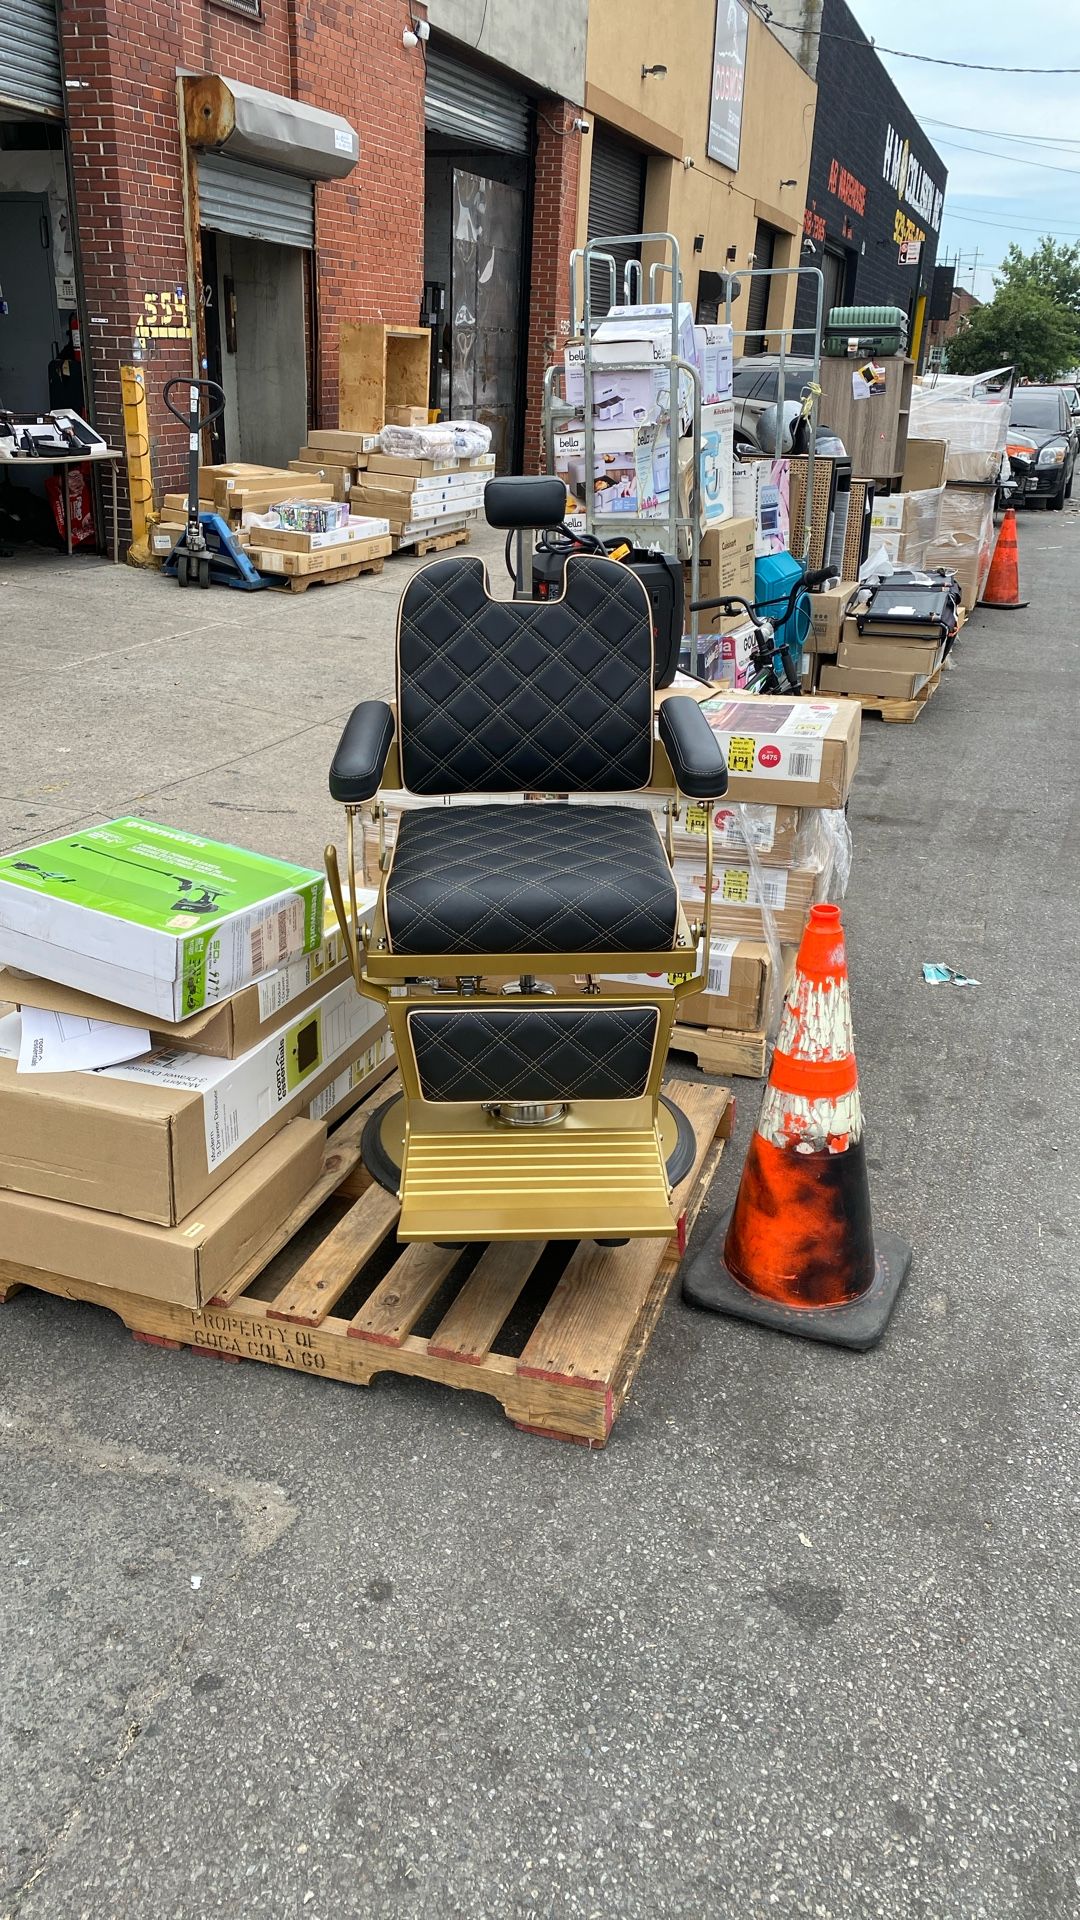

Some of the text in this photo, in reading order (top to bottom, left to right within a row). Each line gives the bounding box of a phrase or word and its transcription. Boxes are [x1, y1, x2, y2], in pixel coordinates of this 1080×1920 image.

[144, 292, 187, 328] 554
[569, 350, 585, 361] bell
[559, 437, 579, 448] bella
[123, 821, 208, 848] greenworks
[310, 884, 319, 949] greenworks
[124, 1065, 162, 1077] Dresser
[162, 1078, 201, 1088] Modern
[191, 1311, 316, 1348] PROPERTY OF
